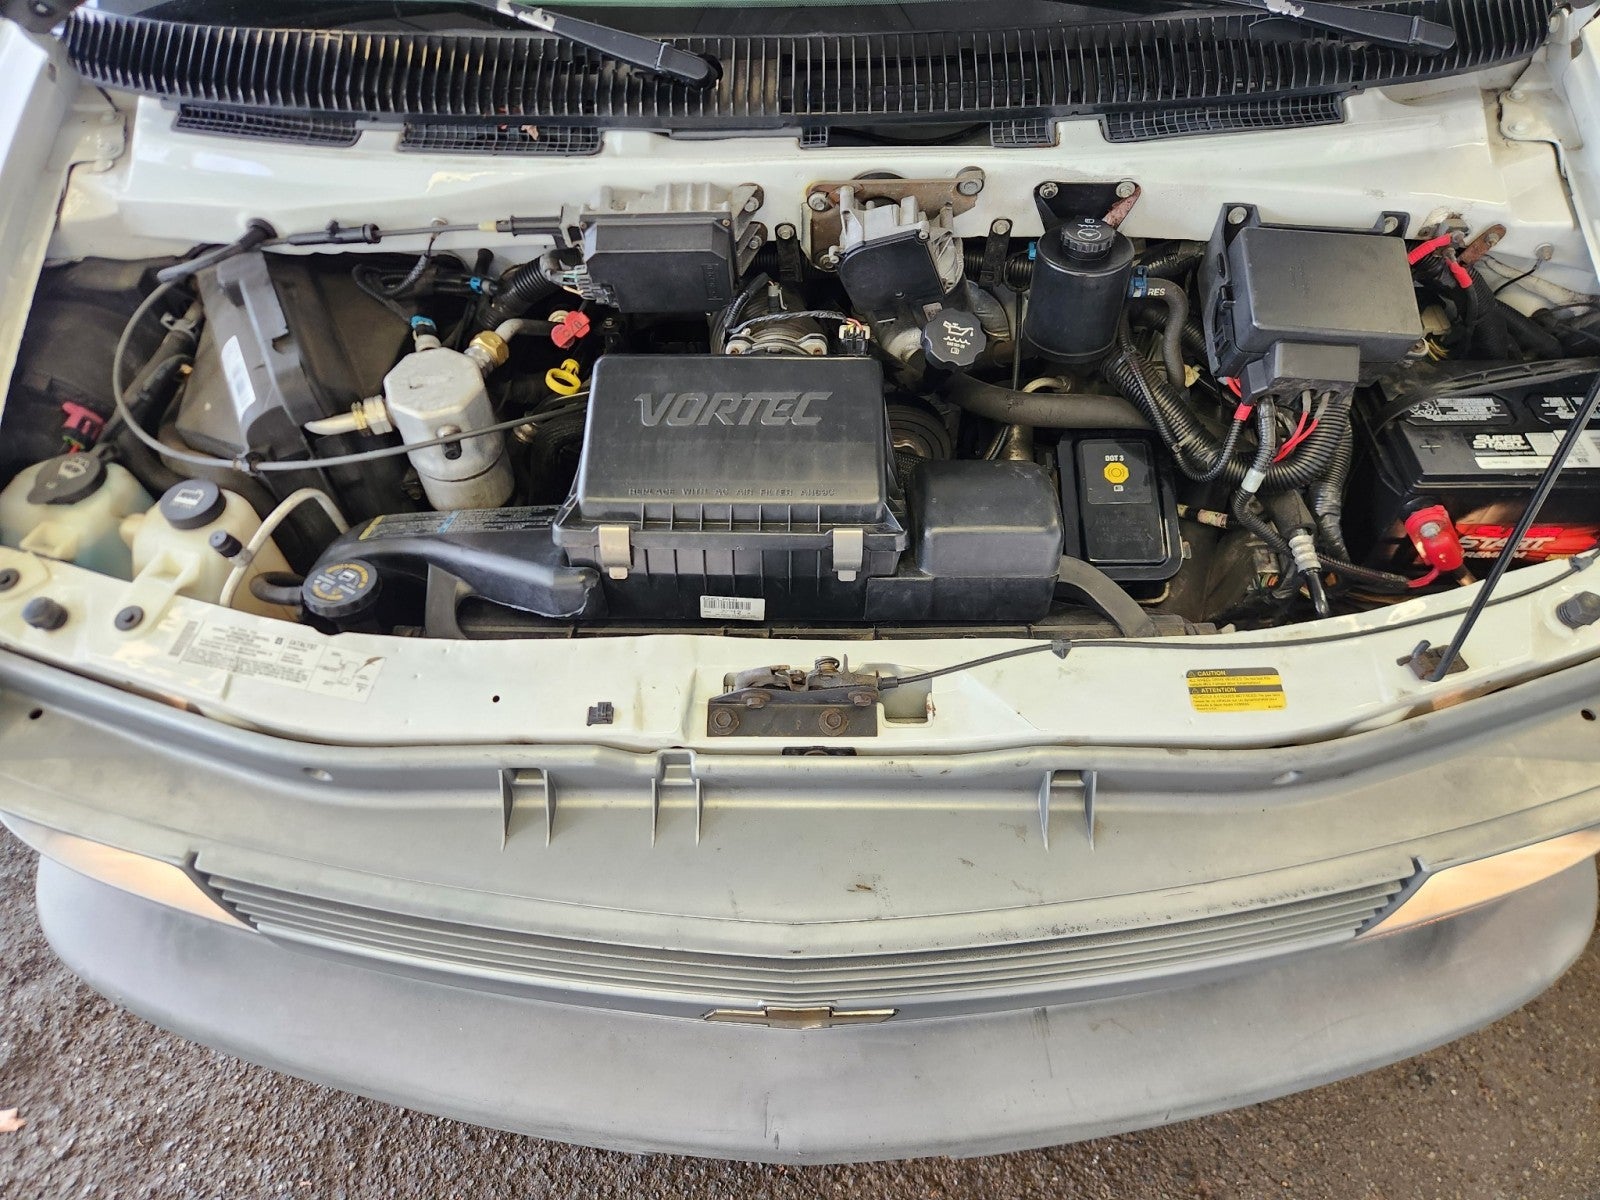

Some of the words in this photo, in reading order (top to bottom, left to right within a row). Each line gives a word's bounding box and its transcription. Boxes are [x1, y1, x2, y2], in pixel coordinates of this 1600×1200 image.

[1147, 287, 1166, 296] RES
[633, 391, 834, 427] VORTEC
[1119, 454, 1125, 462] 3
[628, 487, 676, 497] REPLACE
[681, 488, 709, 497] WITH
[759, 488, 794, 498] FILTER
